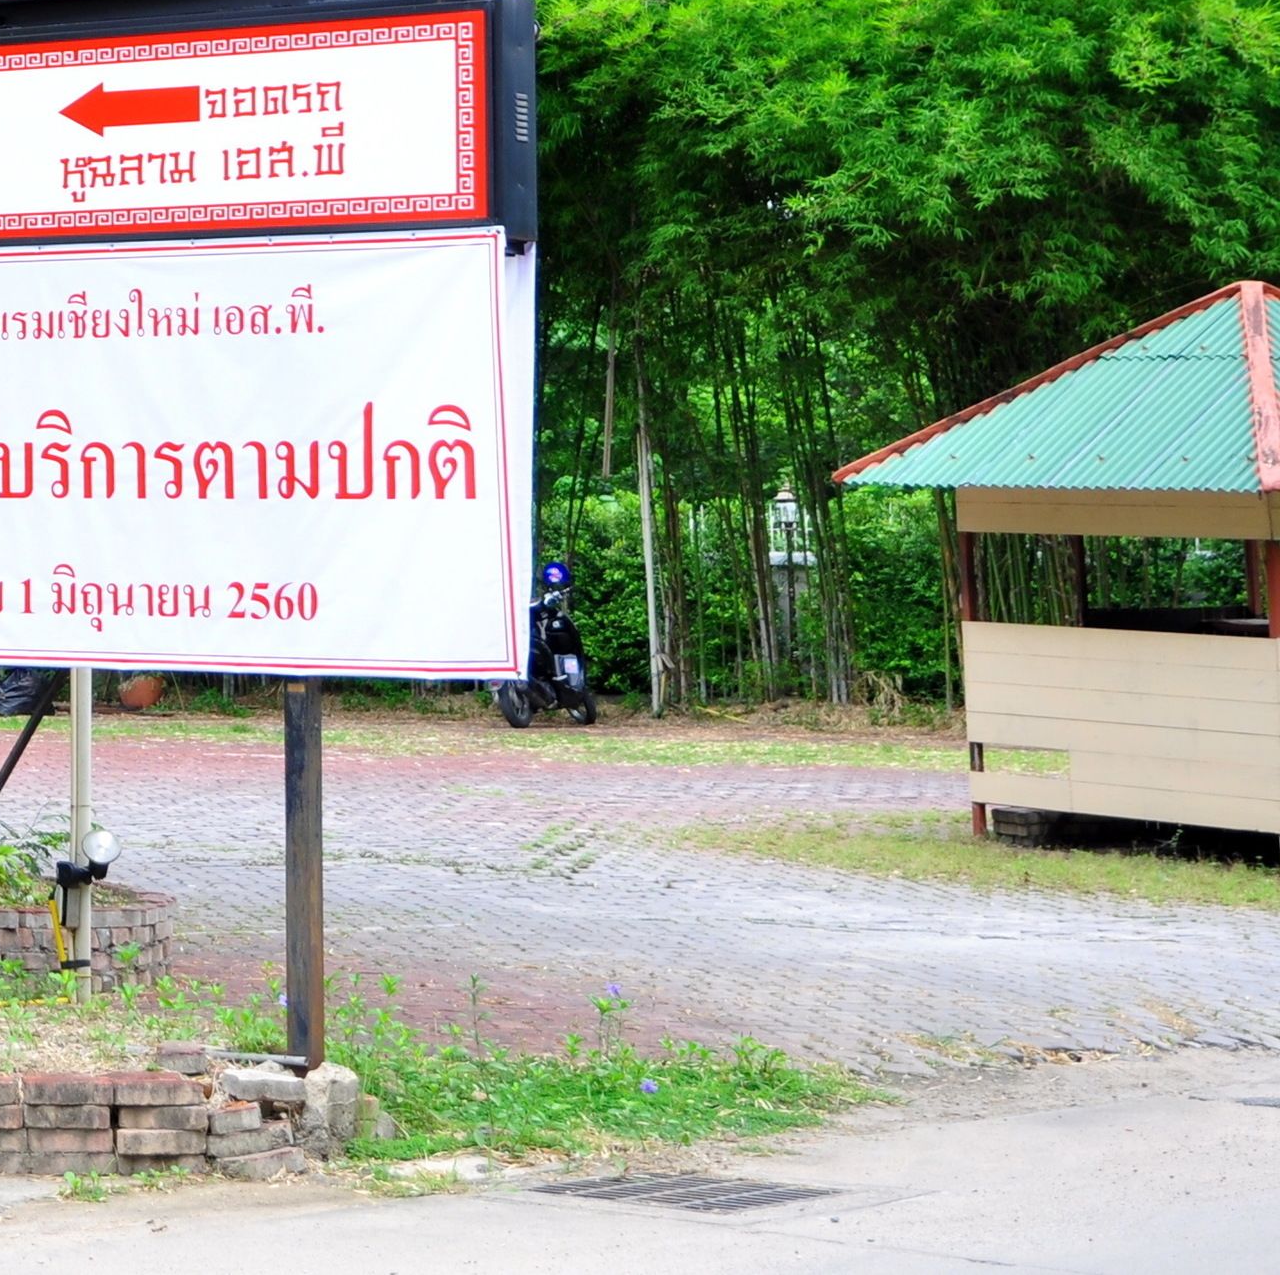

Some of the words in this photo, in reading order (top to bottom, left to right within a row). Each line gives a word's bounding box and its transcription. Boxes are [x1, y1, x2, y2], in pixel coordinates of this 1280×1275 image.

[204, 80, 344, 120] จอดรถ
[59, 150, 197, 203] หูฉลาม
[222, 121, 346, 182] เอส.พี
[213, 283, 326, 336] เอส.พี.
[21, 577, 34, 616] 1
[51, 563, 212, 633] มิถุนายน
[226, 580, 319, 622] 2560
